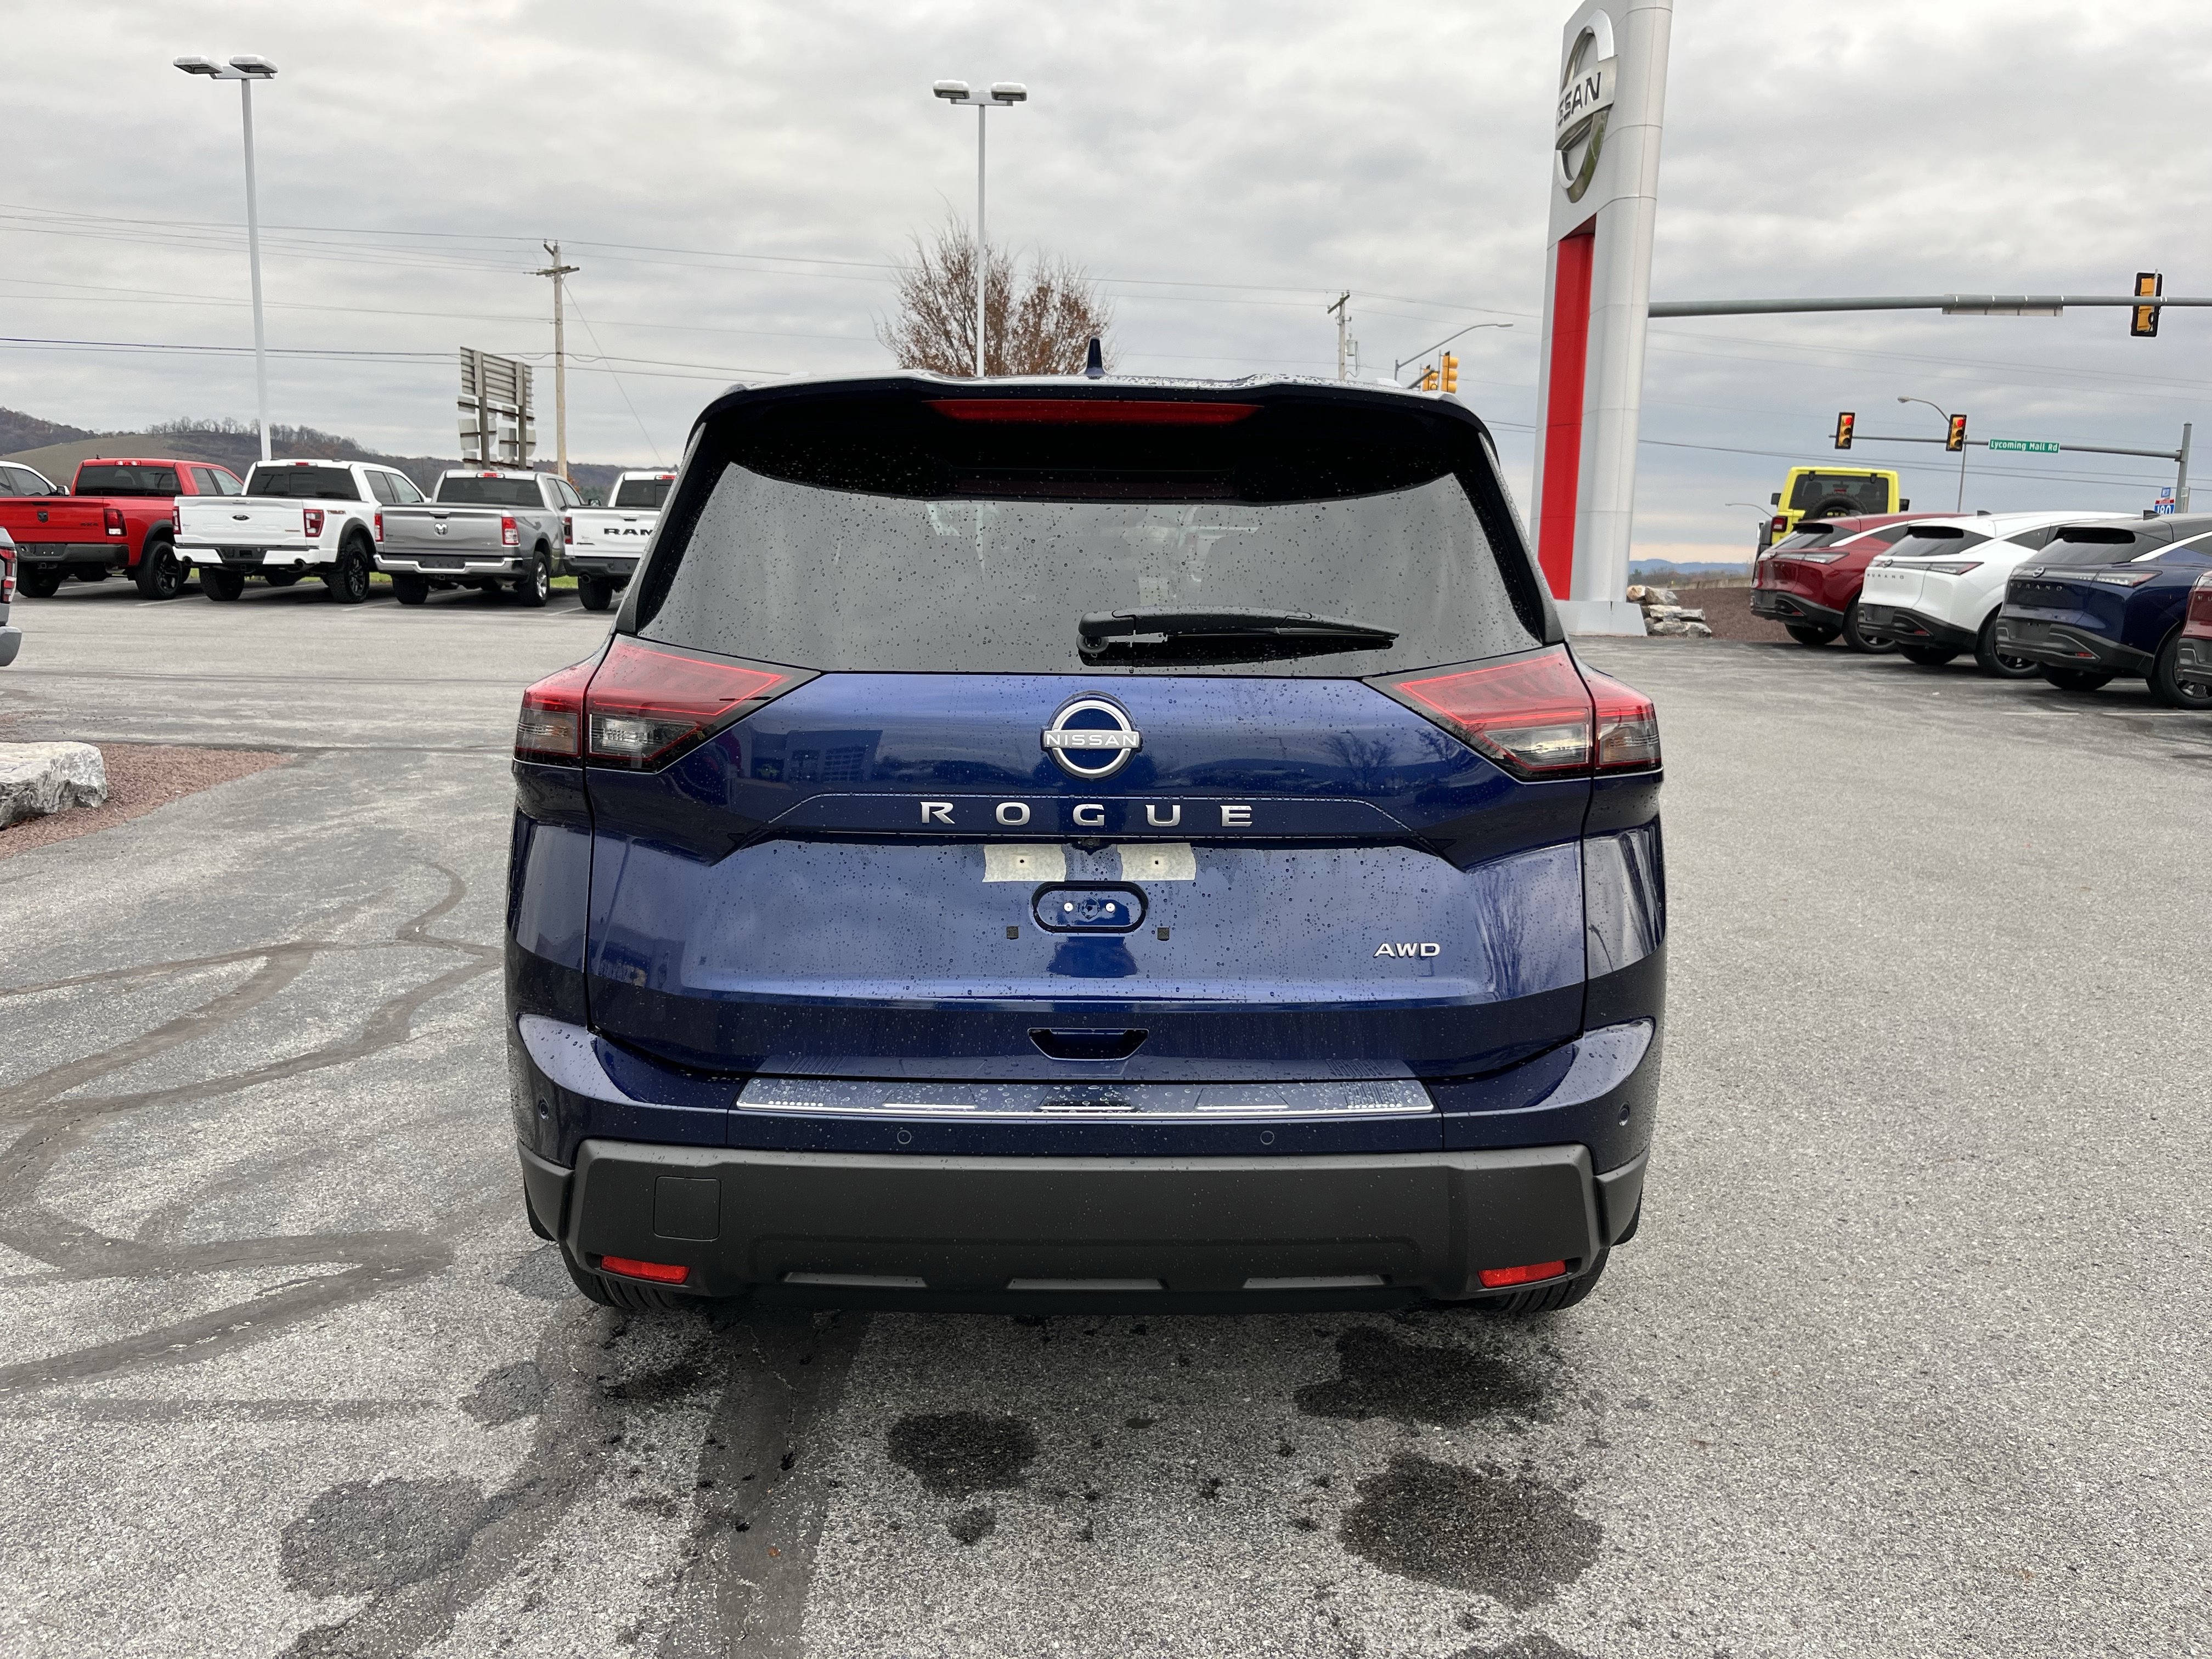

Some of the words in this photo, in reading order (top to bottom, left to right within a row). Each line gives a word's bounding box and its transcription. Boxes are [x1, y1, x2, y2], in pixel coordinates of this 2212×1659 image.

[1558, 71, 1601, 128] SSAN
[1991, 441, 2027, 452] Lycoming
[2029, 442, 2046, 451] Mall
[2048, 443, 2058, 452] Rd
[1046, 734, 1137, 746] NISSAN
[920, 802, 1253, 827] ROGUE
[1373, 943, 1441, 958] AWD
